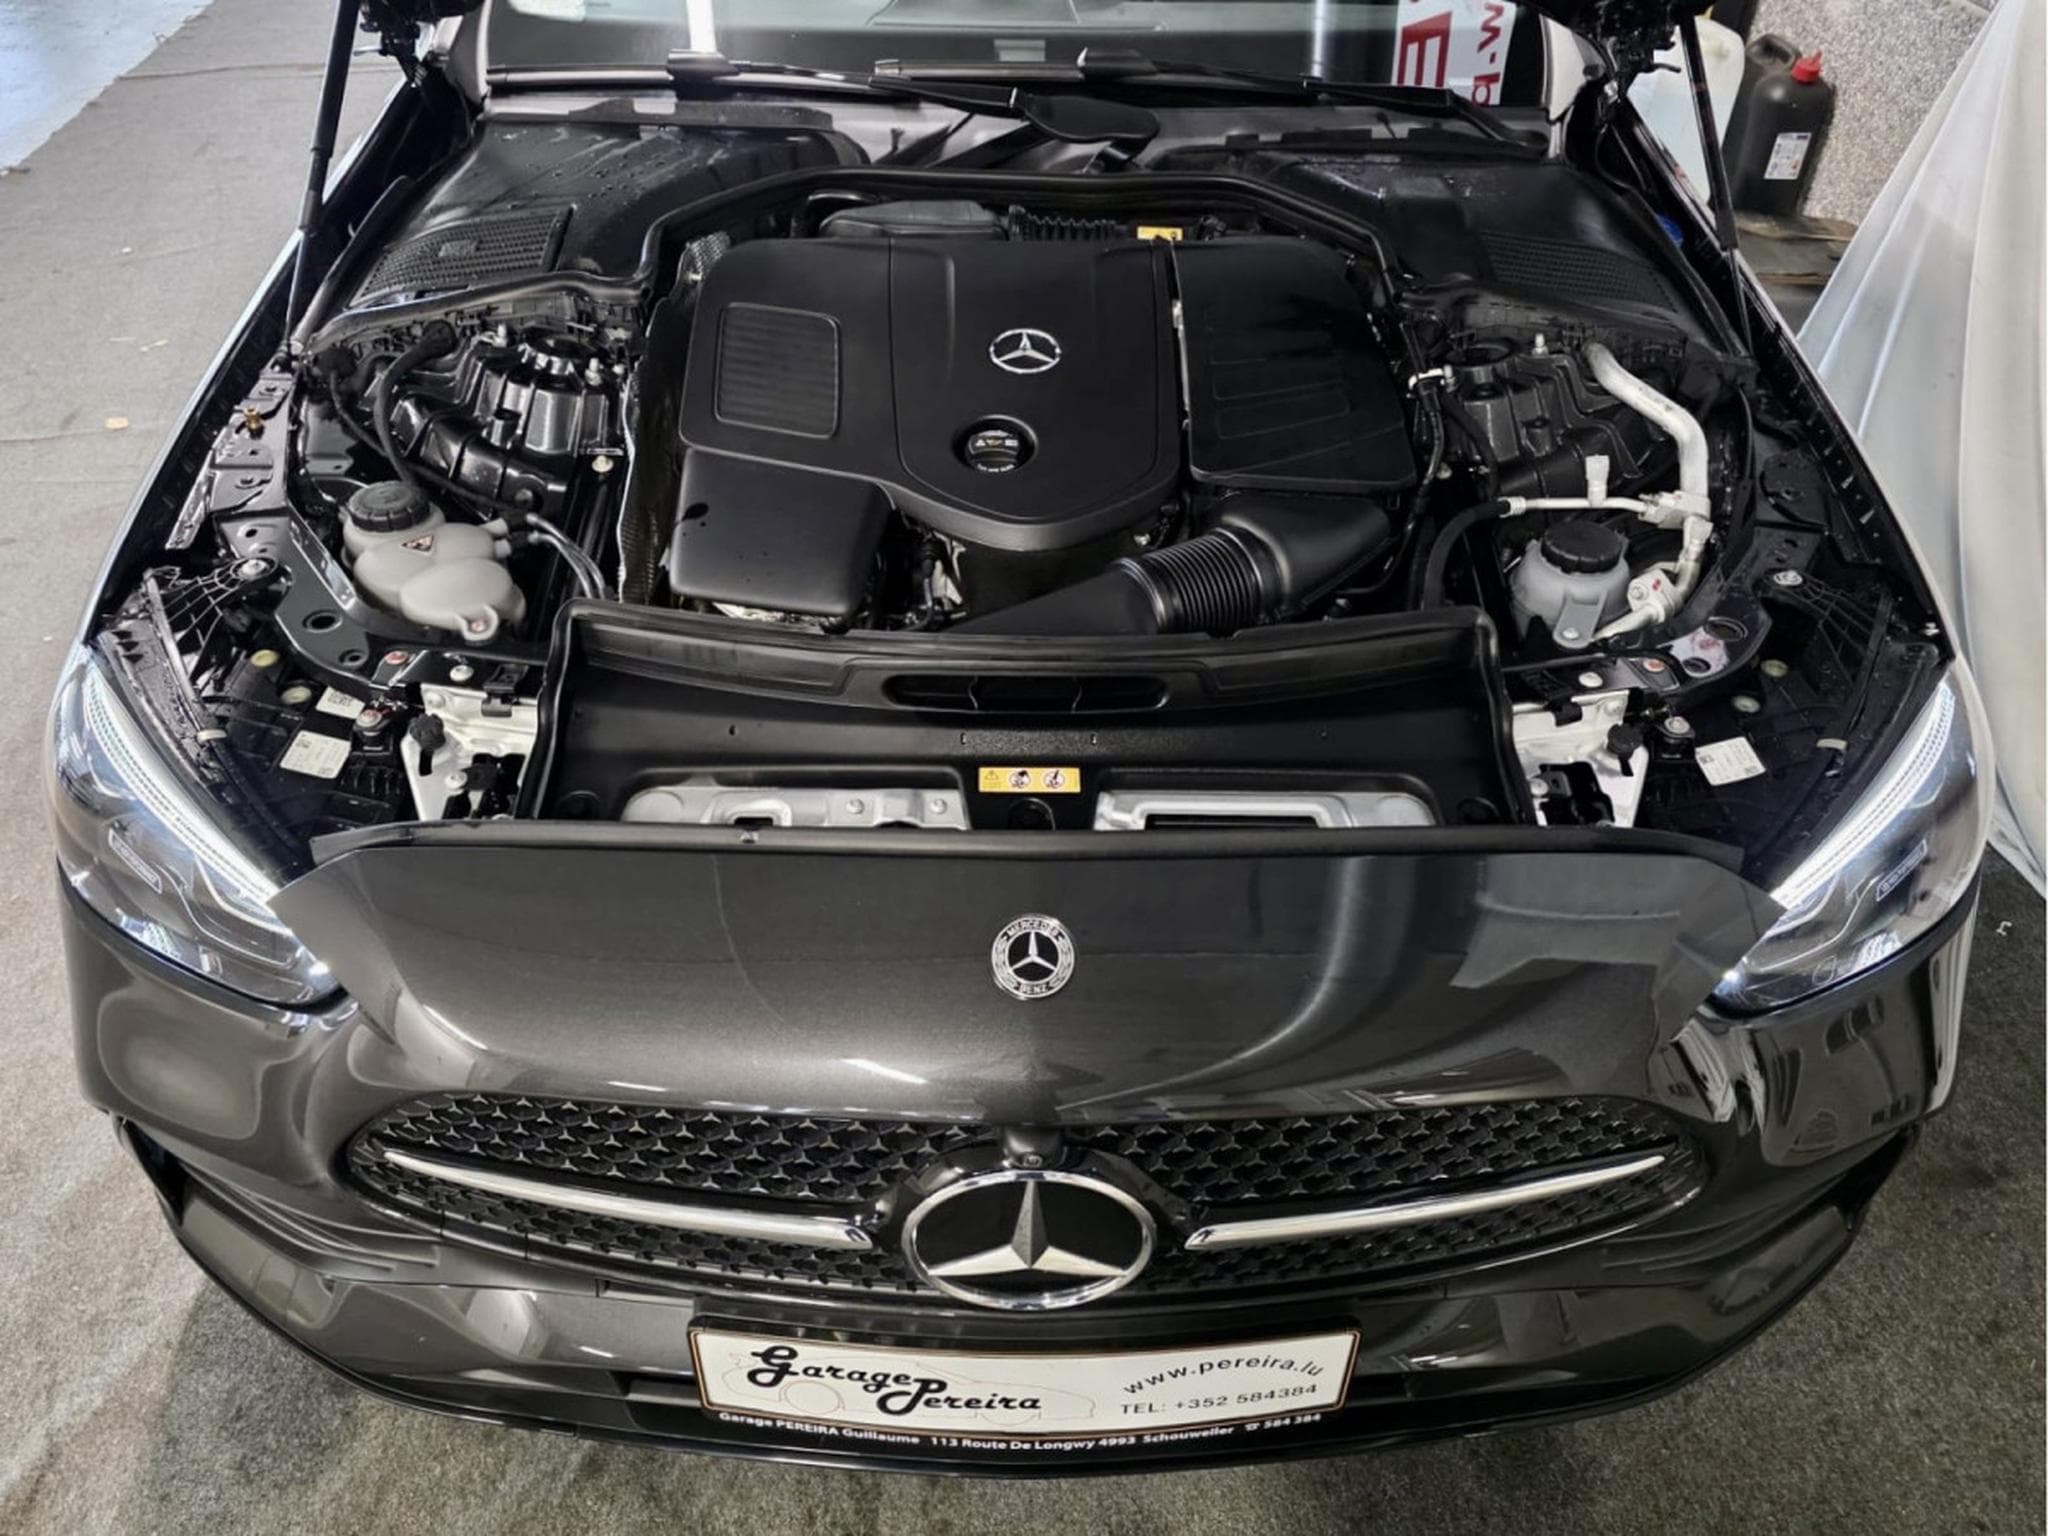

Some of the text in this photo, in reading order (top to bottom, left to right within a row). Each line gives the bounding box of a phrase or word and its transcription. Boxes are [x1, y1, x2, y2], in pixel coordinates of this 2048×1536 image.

[1006, 919, 1059, 937] MERCEDES
[1018, 982, 1050, 995] BENZ
[747, 1345, 911, 1393] Garage
[1123, 1355, 1324, 1395] www.pereira.lu
[876, 1378, 1042, 1416] Pereira
[1121, 1384, 1317, 1415] TEL: +352 584384
[719, 1412, 1321, 1452] Garage PEREIRA Guillaume 113 Route De Longwy 4993 Schouweiler 584 384
